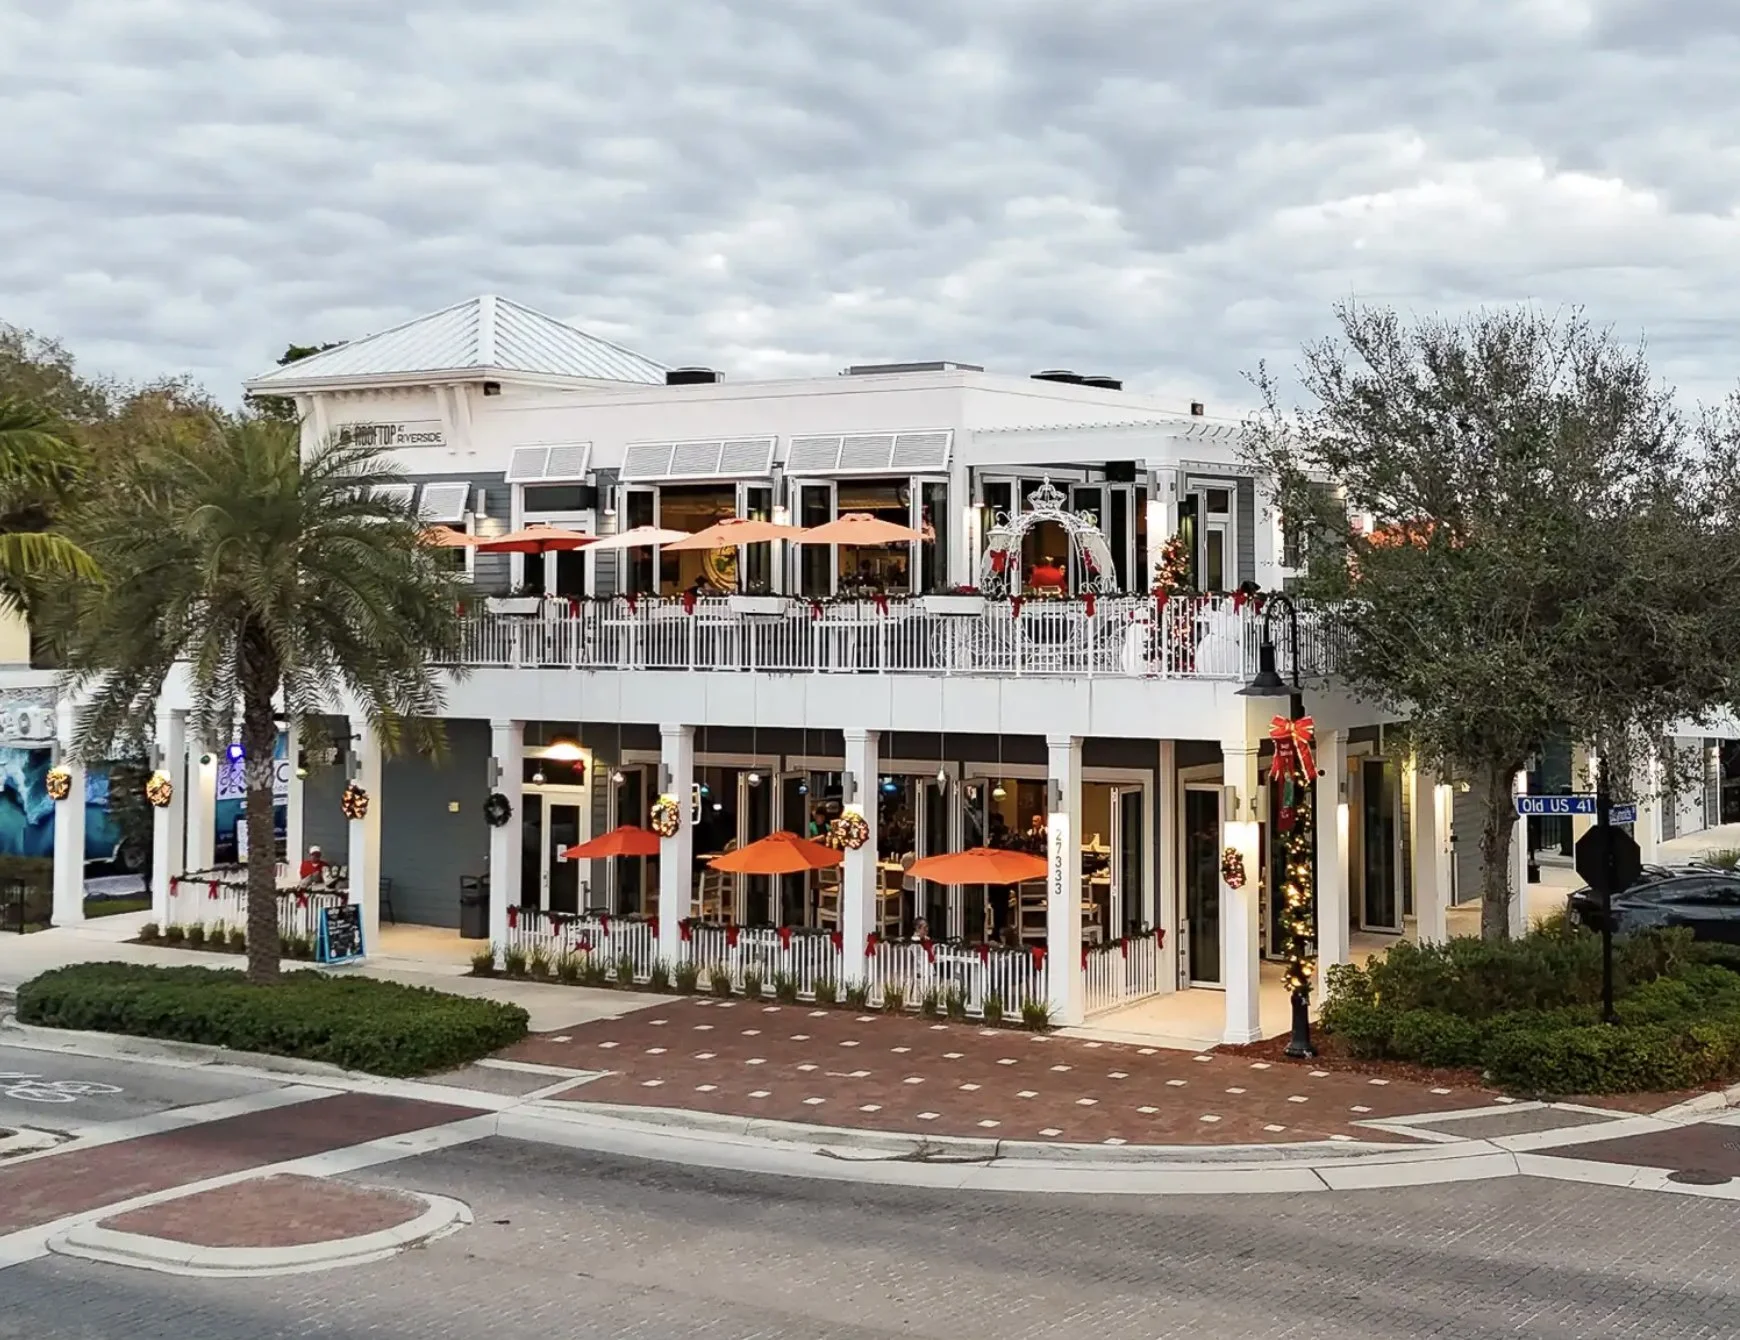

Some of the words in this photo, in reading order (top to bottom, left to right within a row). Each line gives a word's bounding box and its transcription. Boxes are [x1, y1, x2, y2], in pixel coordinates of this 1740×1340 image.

[355, 424, 397, 446] ROOFTOP
[397, 432, 442, 443] RIVERSIDE
[1522, 798, 1544, 812] Old
[1550, 798, 1569, 813] US
[1576, 798, 1591, 812] 41
[1054, 828, 1062, 895] 27333
